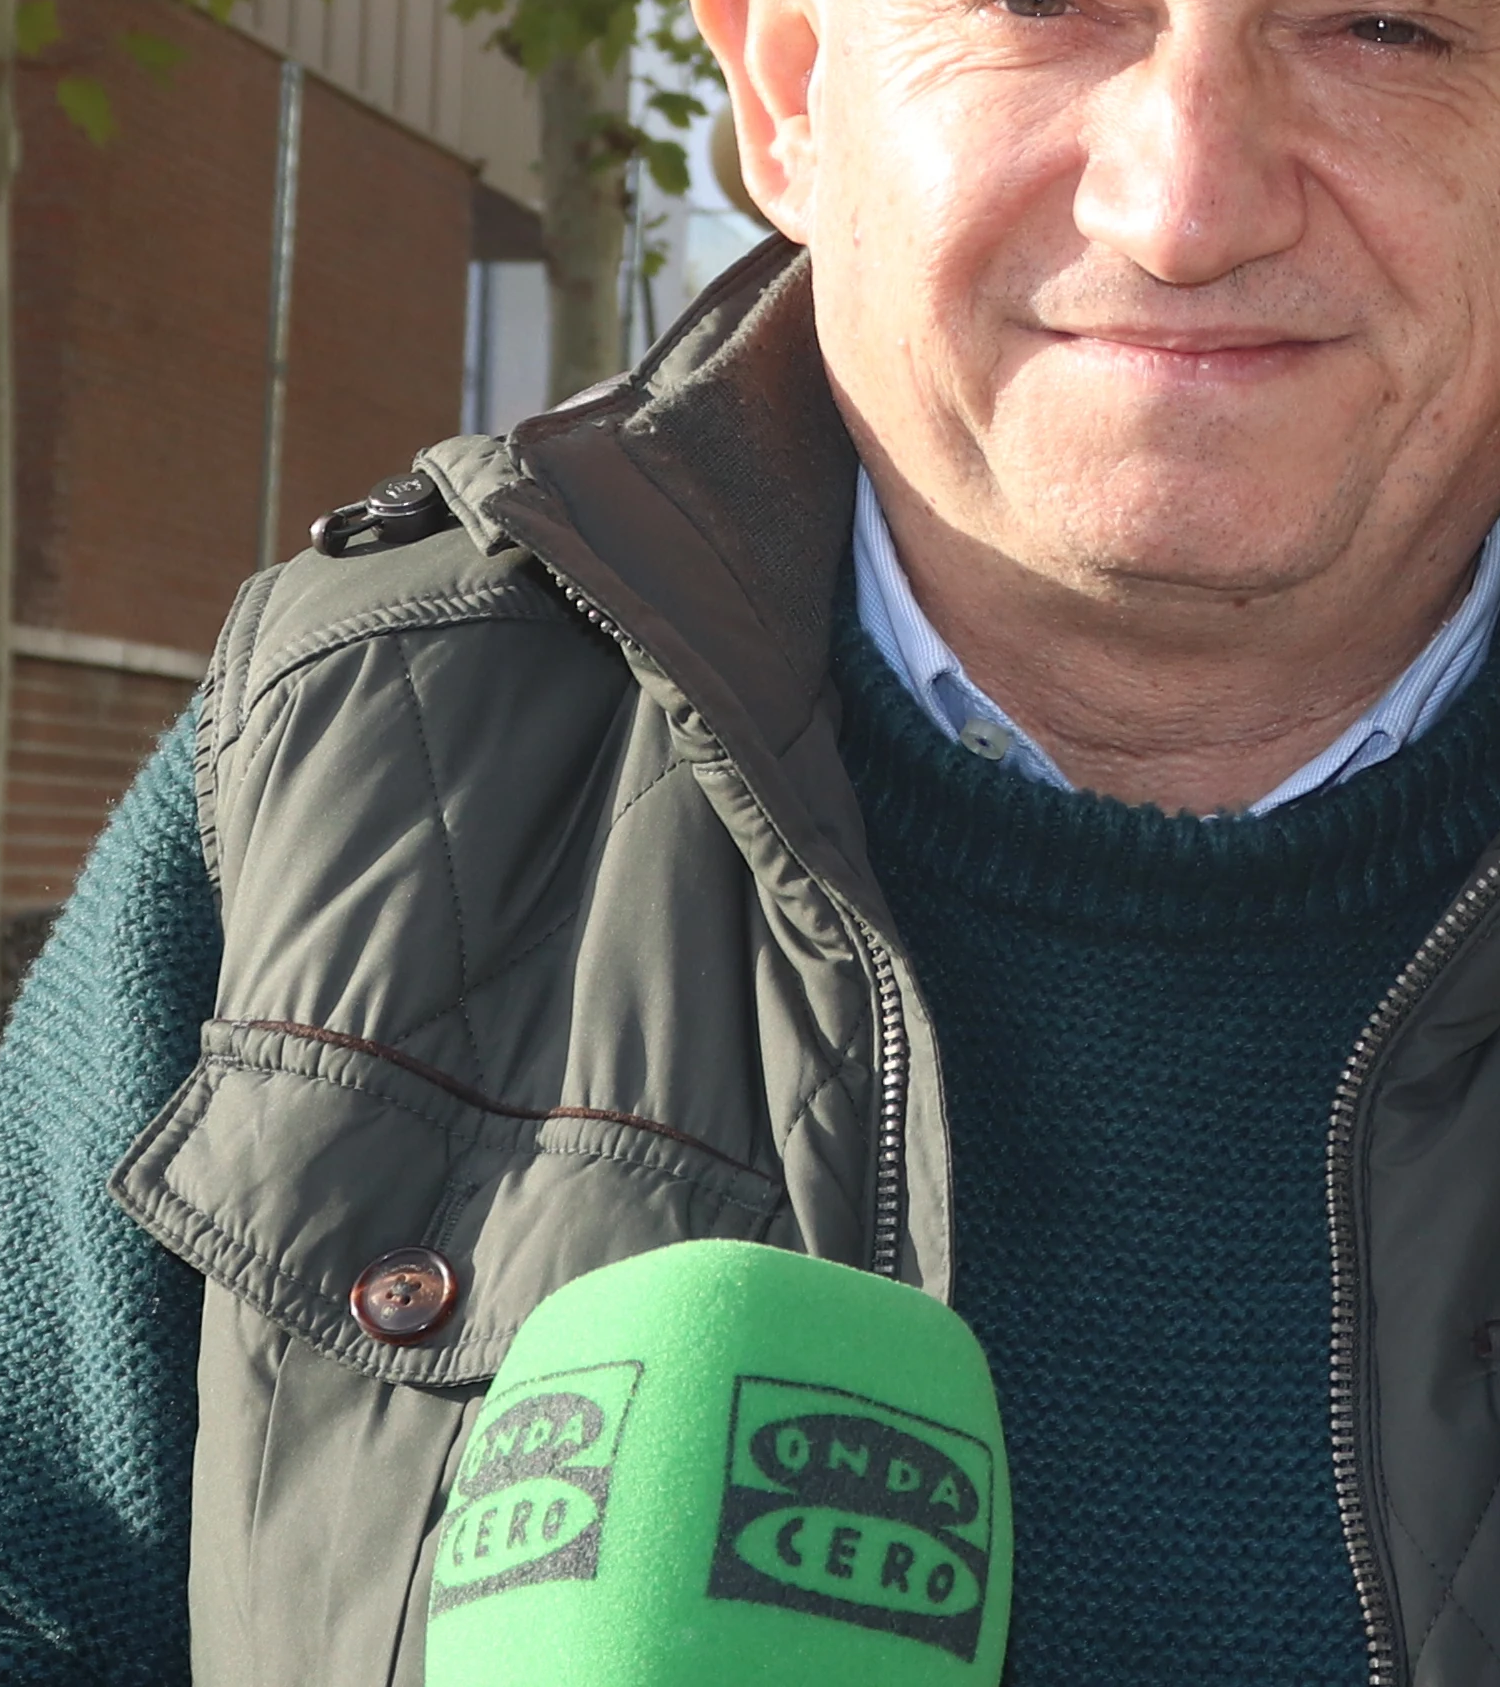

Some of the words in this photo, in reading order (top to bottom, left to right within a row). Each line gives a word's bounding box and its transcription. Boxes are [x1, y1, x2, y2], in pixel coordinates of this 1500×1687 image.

[466, 1413, 584, 1481] ONDA
[776, 1429, 961, 1507] ONDA
[452, 1498, 568, 1566] CERO
[776, 1518, 956, 1603] CERO
